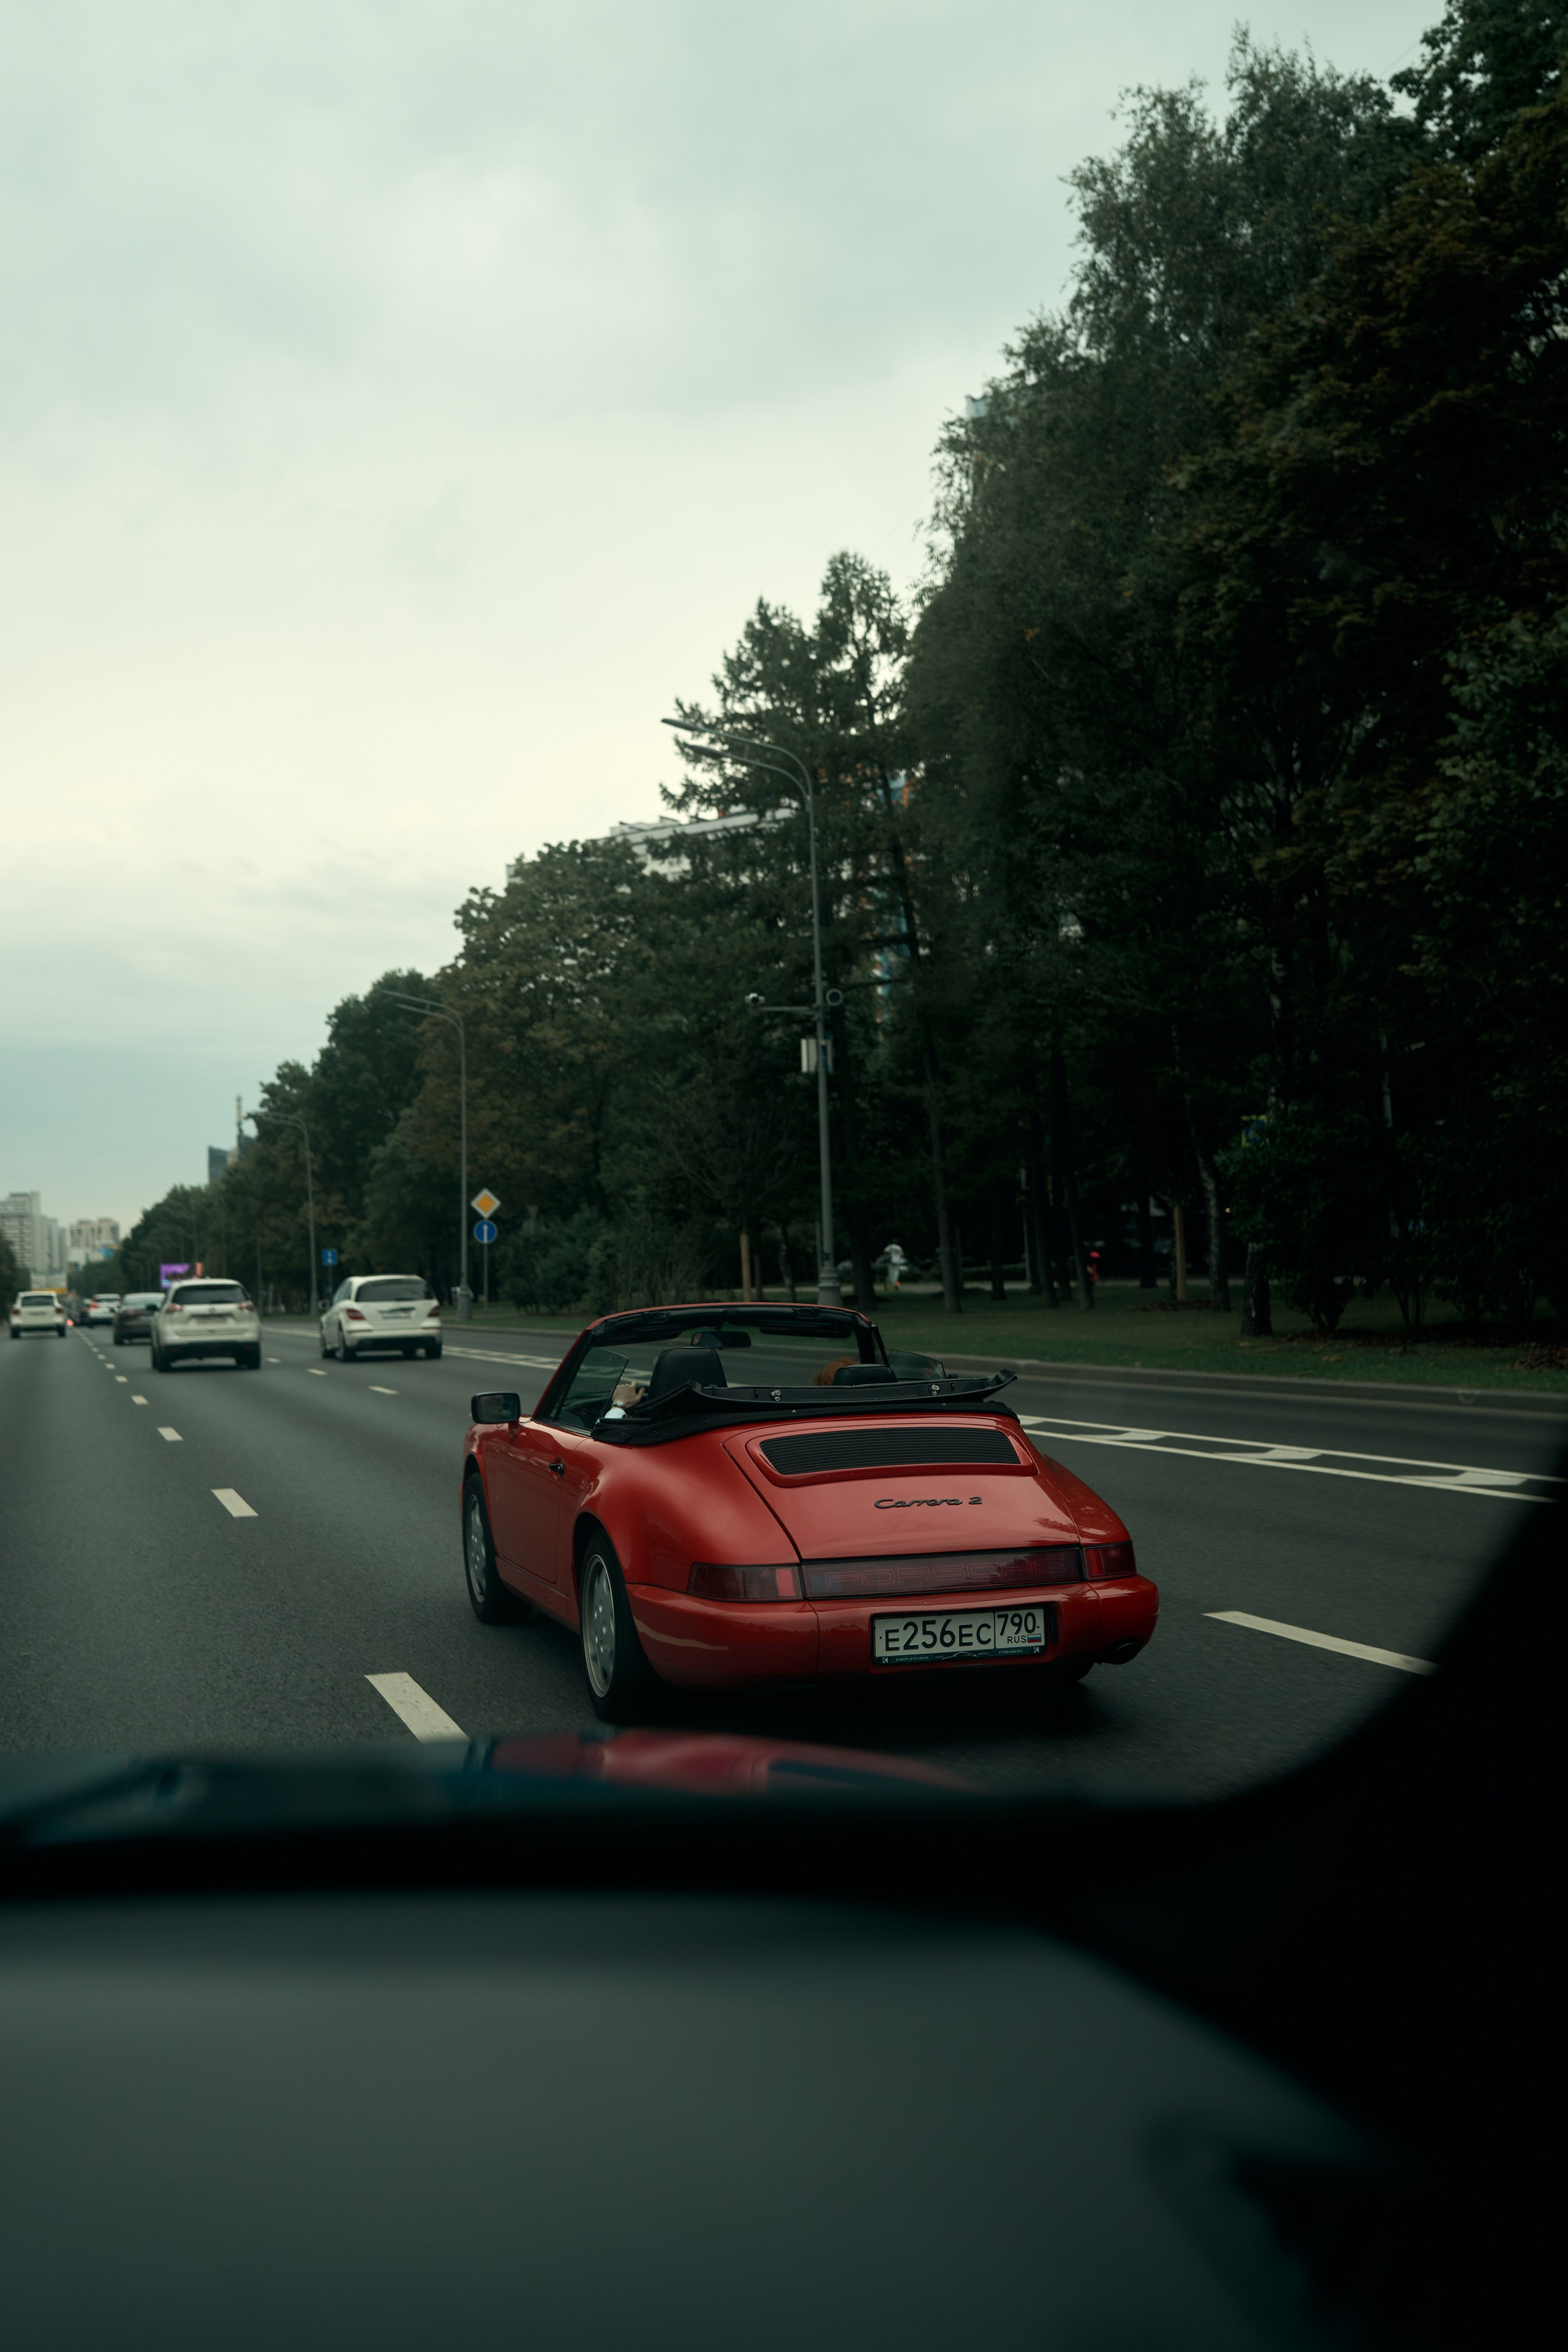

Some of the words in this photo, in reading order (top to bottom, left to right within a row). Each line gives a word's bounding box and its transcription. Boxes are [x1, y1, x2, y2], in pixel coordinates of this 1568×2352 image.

[874, 1498, 963, 1509] Carrera
[968, 1496, 982, 1505] 2
[824, 1558, 1066, 1588] PORSCHE
[997, 1612, 1036, 1636] 790
[1008, 1635, 1027, 1644] RUS
